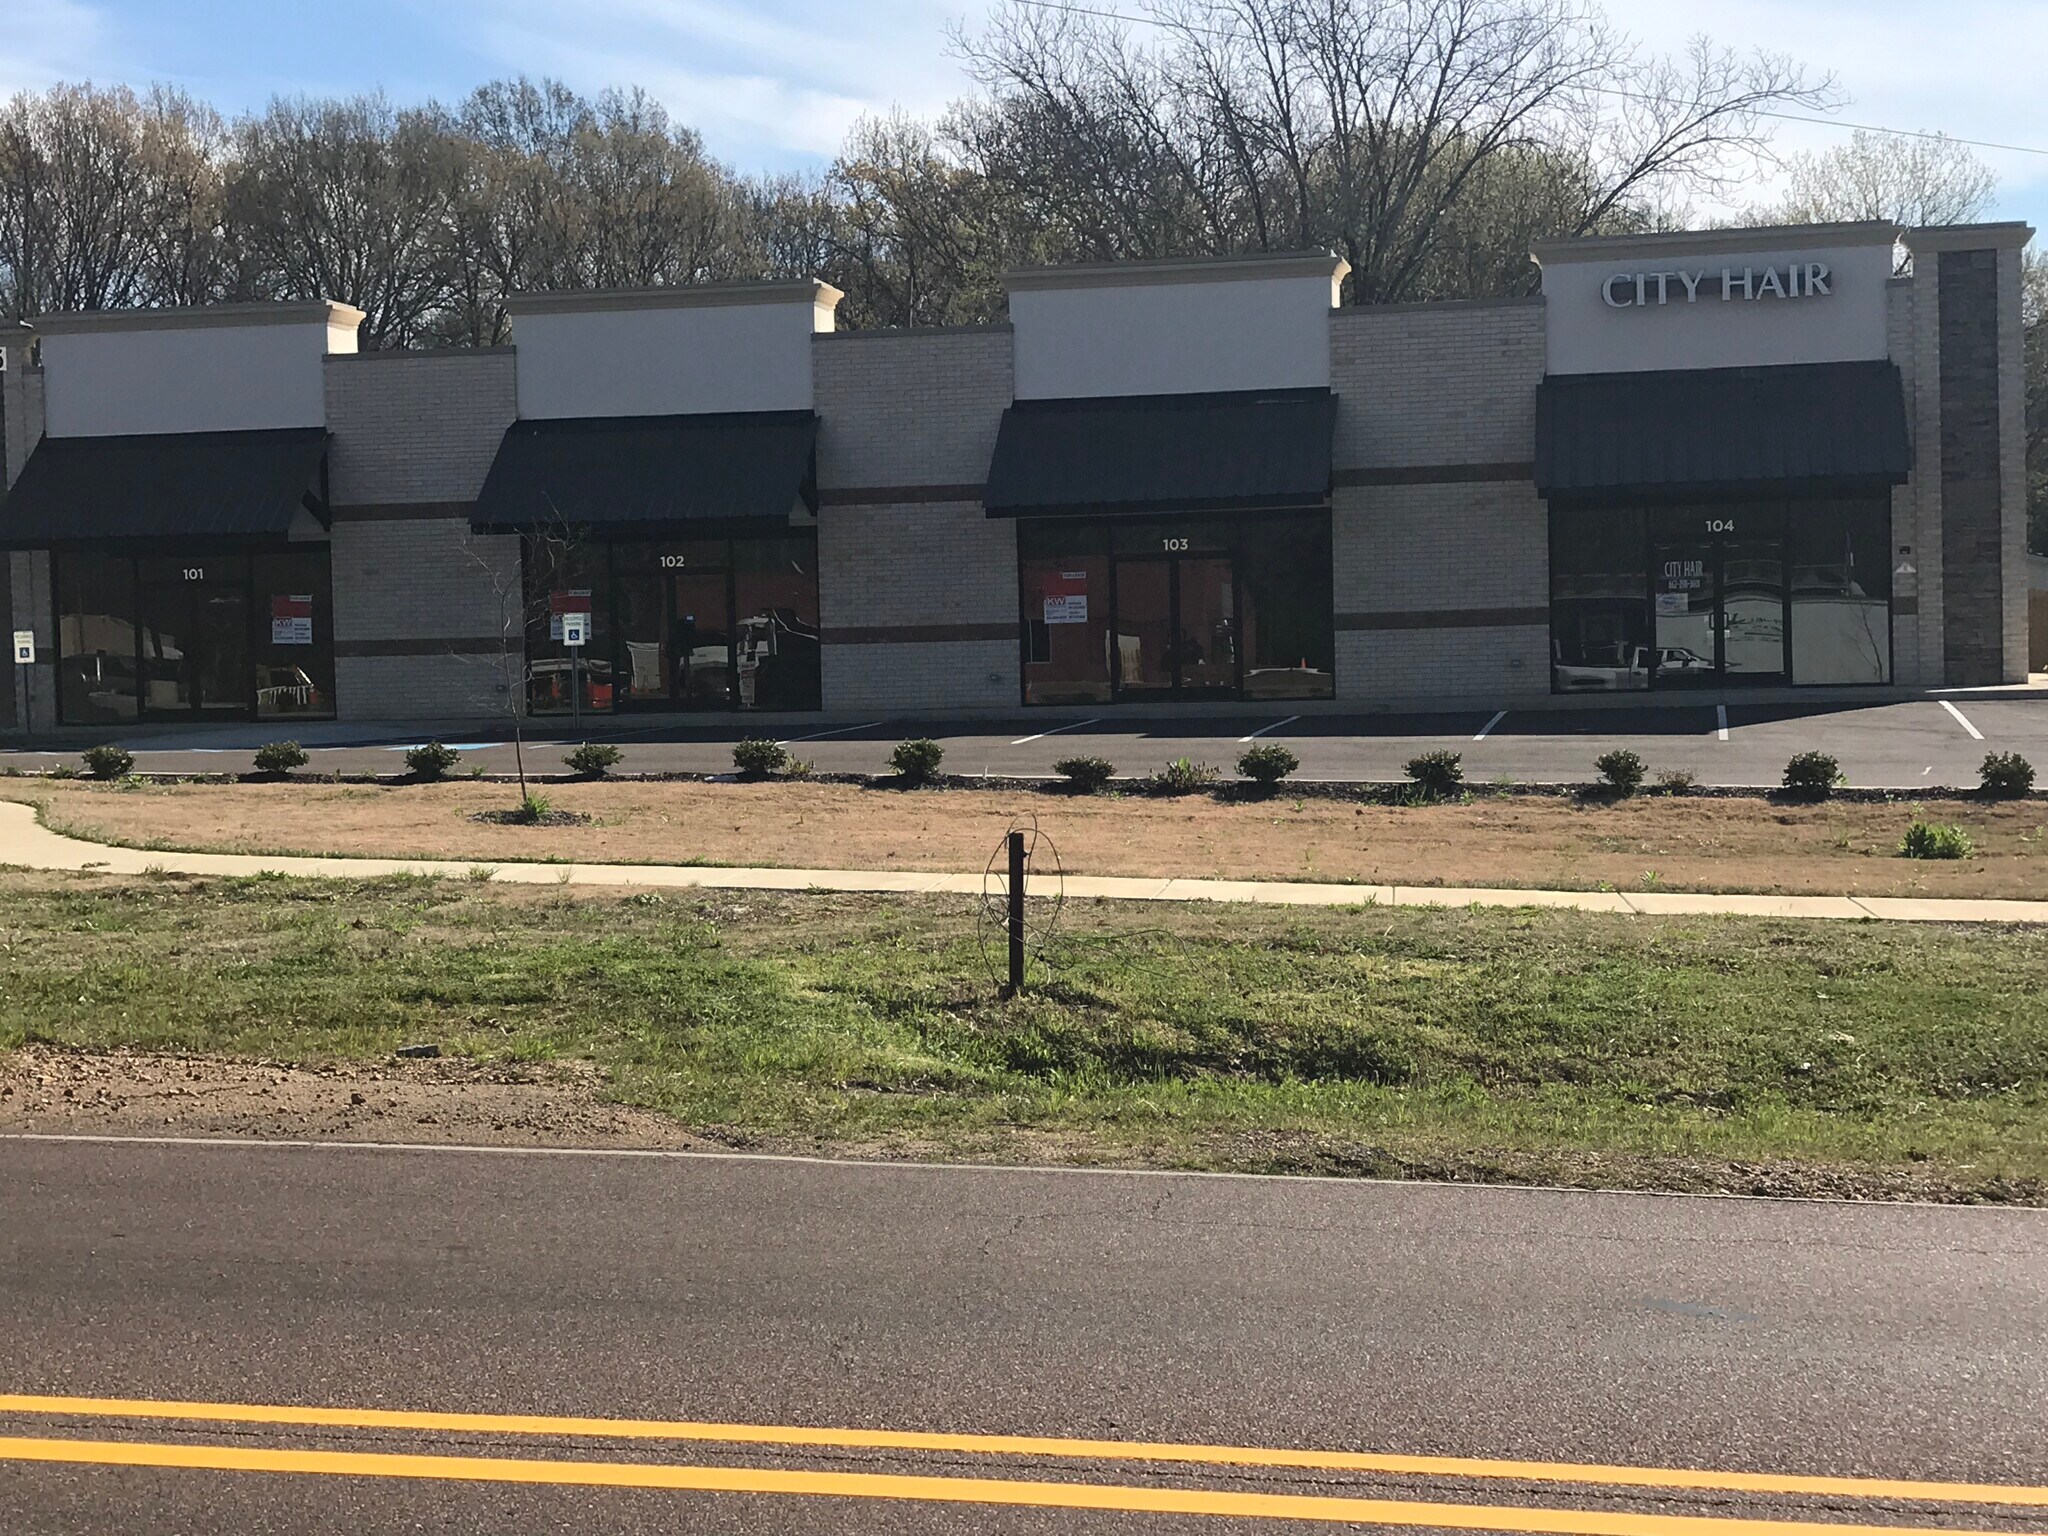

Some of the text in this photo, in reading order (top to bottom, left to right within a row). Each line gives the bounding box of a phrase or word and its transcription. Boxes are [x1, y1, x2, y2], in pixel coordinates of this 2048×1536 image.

[1601, 262, 1832, 308] CITY HAIR
[1705, 519, 1735, 532] 104
[1162, 538, 1189, 551] 103
[660, 555, 685, 568] 102
[182, 568, 203, 580] 101
[1664, 560, 1703, 577] CITY HAIR
[1047, 597, 1065, 605] KW
